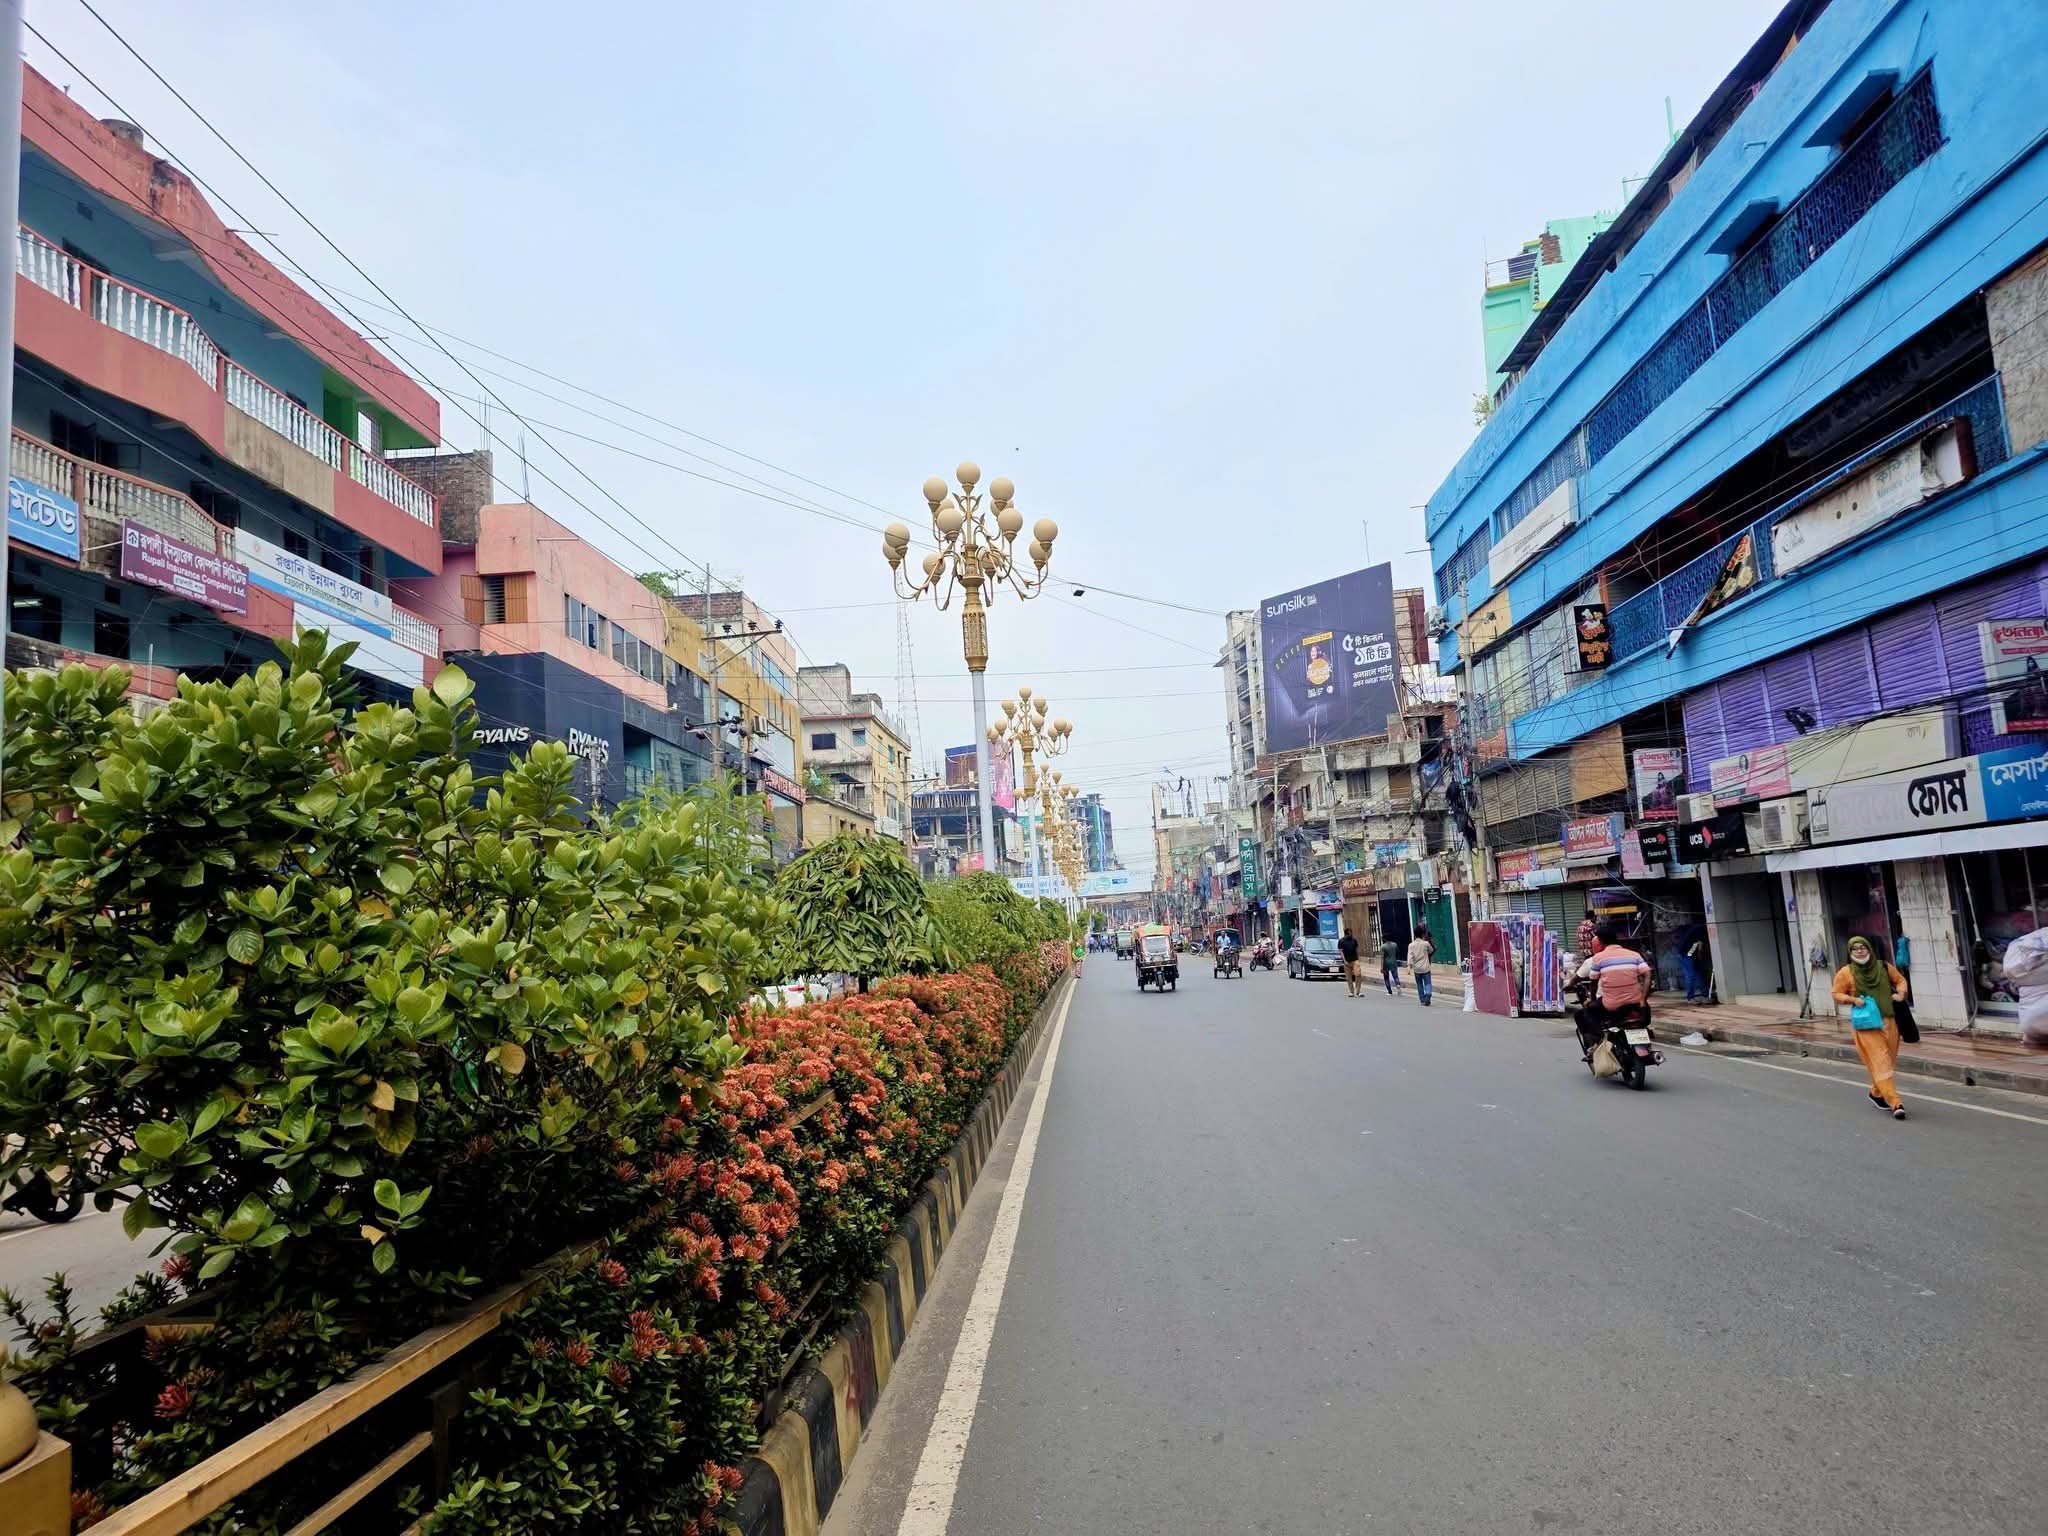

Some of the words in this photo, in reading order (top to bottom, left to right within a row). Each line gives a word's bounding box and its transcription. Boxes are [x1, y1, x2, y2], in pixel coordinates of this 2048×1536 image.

[142, 552, 165, 569] Rupali
[166, 561, 200, 582] Insurance
[201, 574, 233, 594] Company
[222, 562, 247, 585] লিমিটেড
[275, 553, 304, 576] রপ্তানি
[308, 565, 336, 589] উন্নয়ন
[339, 582, 363, 602] ব্যুরো
[284, 574, 305, 593] Export
[1266, 594, 1307, 617] sunsilk
[472, 727, 530, 744] RYANS
[1907, 769, 1969, 818] ফোম
[1689, 834, 1703, 845] UCB
